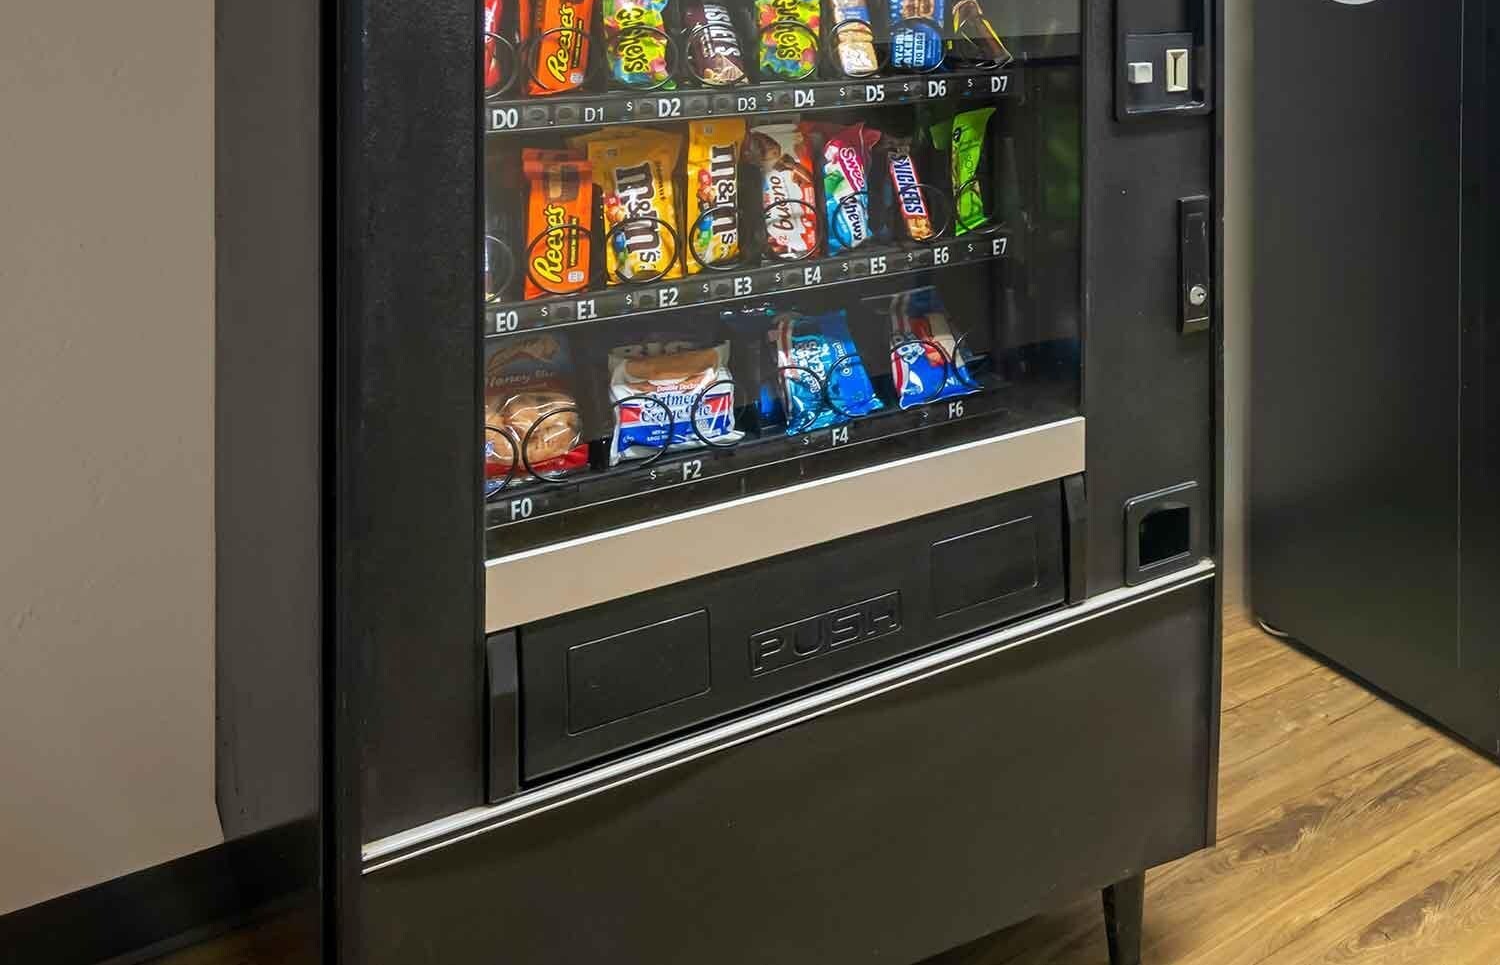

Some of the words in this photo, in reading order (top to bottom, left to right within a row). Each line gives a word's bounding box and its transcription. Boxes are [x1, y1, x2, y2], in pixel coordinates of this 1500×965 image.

[547, 3, 576, 82] Reese's
[866, 84, 885, 103] D5
[928, 80, 946, 97] D6
[991, 76, 1008, 93] D7
[658, 98, 680, 116] D2
[738, 96, 756, 111] D3
[794, 90, 815, 108] D4
[492, 109, 518, 128] D0
[585, 107, 604, 122] D1
[772, 175, 794, 231] bueno
[532, 204, 564, 284] Reese's
[992, 238, 1008, 255] E7
[934, 247, 950, 264] E6
[870, 256, 887, 275] E5
[804, 266, 821, 285] E4
[734, 276, 752, 296] E3
[659, 288, 679, 307] E2
[577, 299, 597, 320] E1
[496, 311, 518, 333] E0
[645, 393, 701, 409] Oatmea
[948, 401, 964, 417] F6
[832, 426, 848, 446] F4
[683, 460, 702, 481] F2
[511, 498, 532, 520] F0
[752, 597, 898, 673] PUSH
